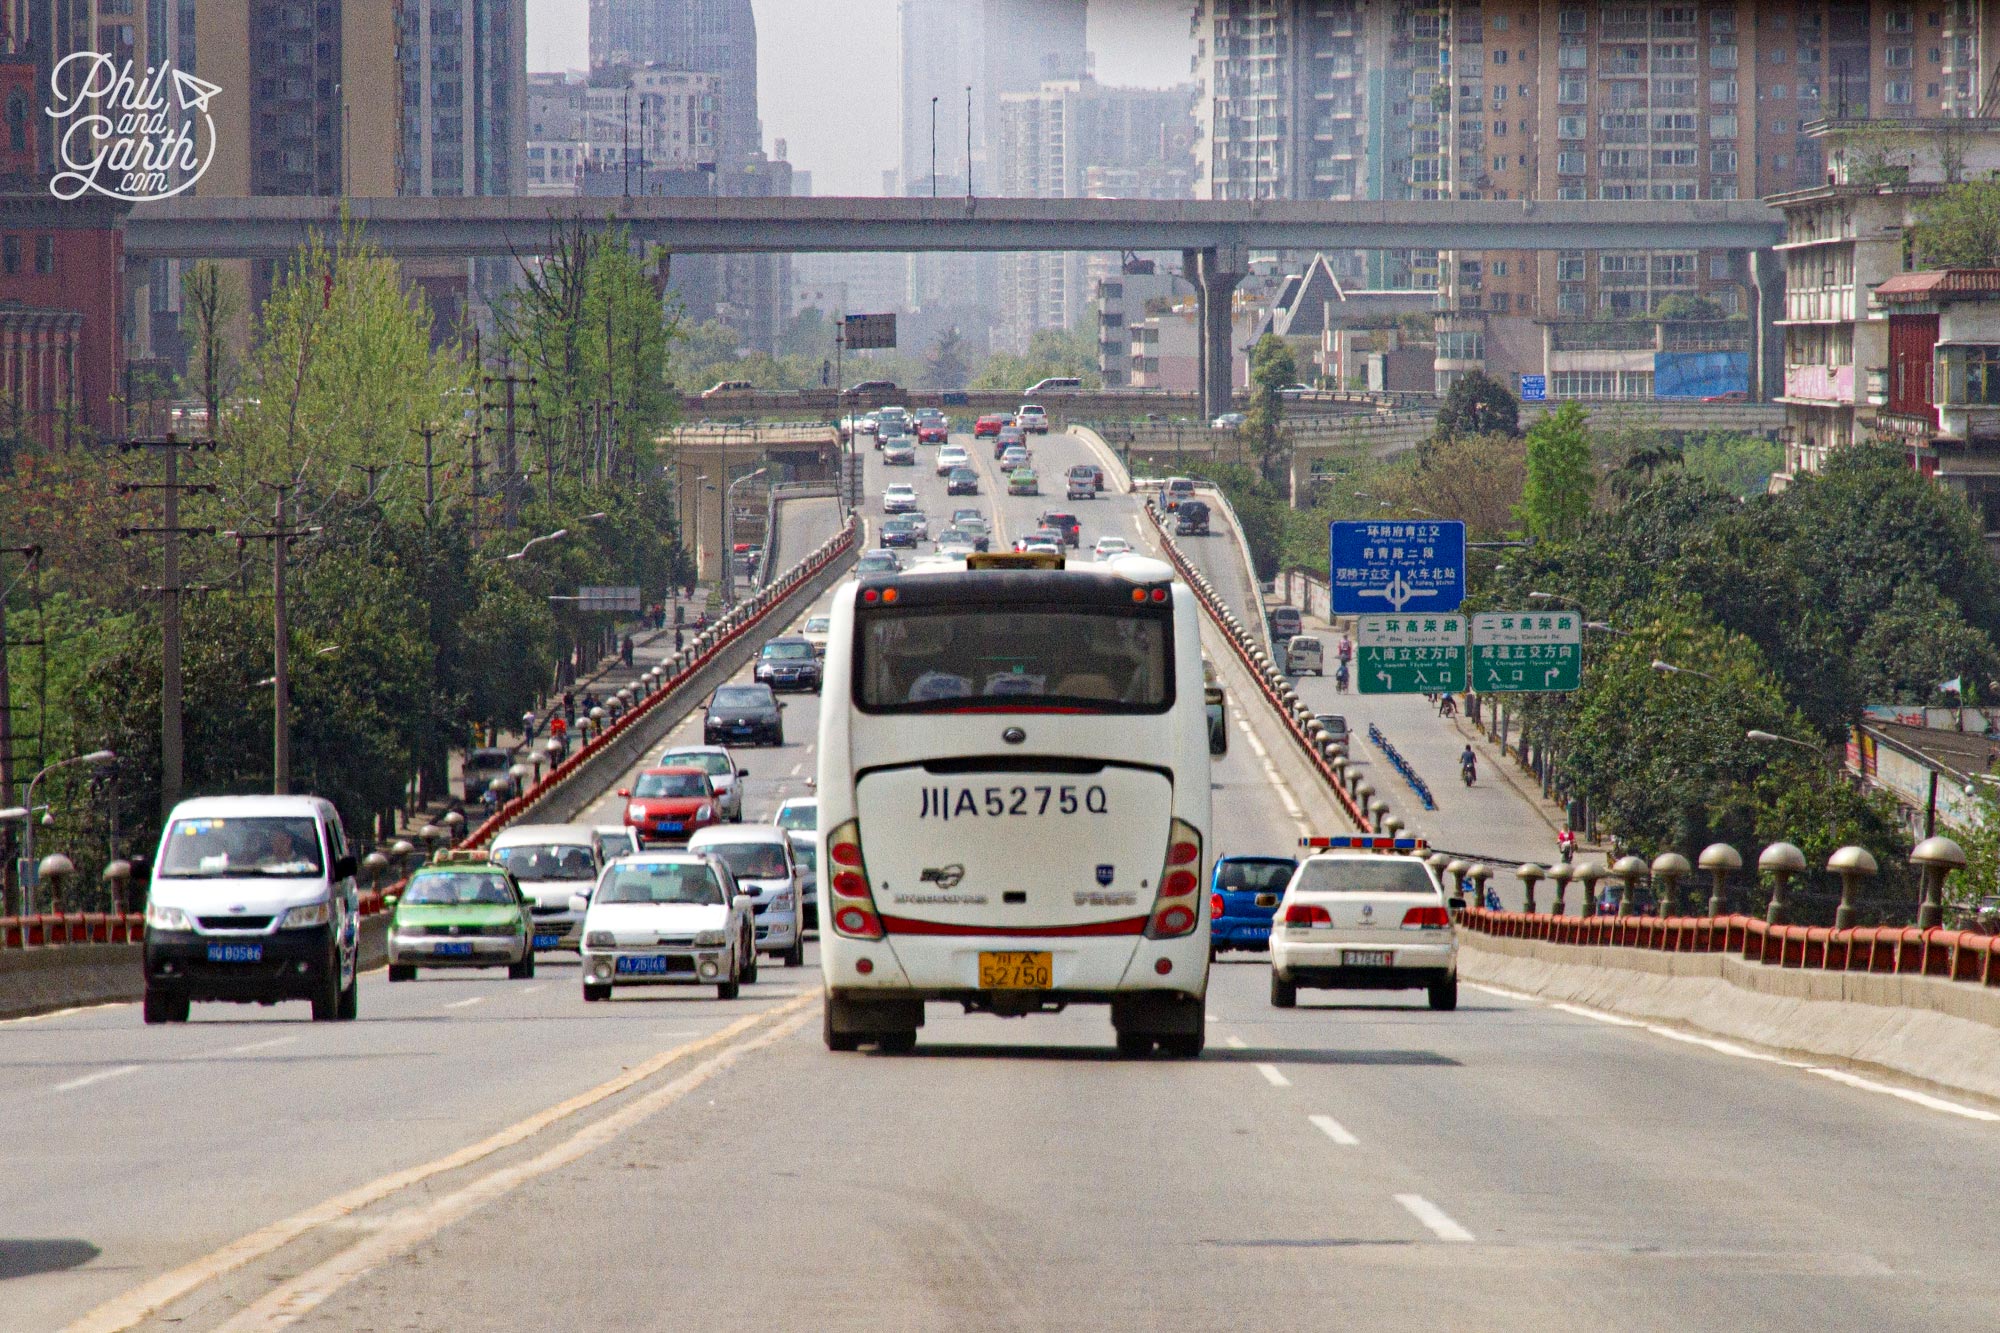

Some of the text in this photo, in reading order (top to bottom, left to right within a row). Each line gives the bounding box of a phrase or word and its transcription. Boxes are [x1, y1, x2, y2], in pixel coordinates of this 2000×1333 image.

[1407, 567, 1456, 579] 火车北站
[1367, 619, 1458, 632] 二环高架路
[1482, 617, 1572, 630] 二环高架路
[1368, 647, 1458, 661] 人南立交方向
[1414, 669, 1451, 683] 入口
[1488, 669, 1523, 681] 入口
[920, 786, 1107, 820] 川A5275Q
